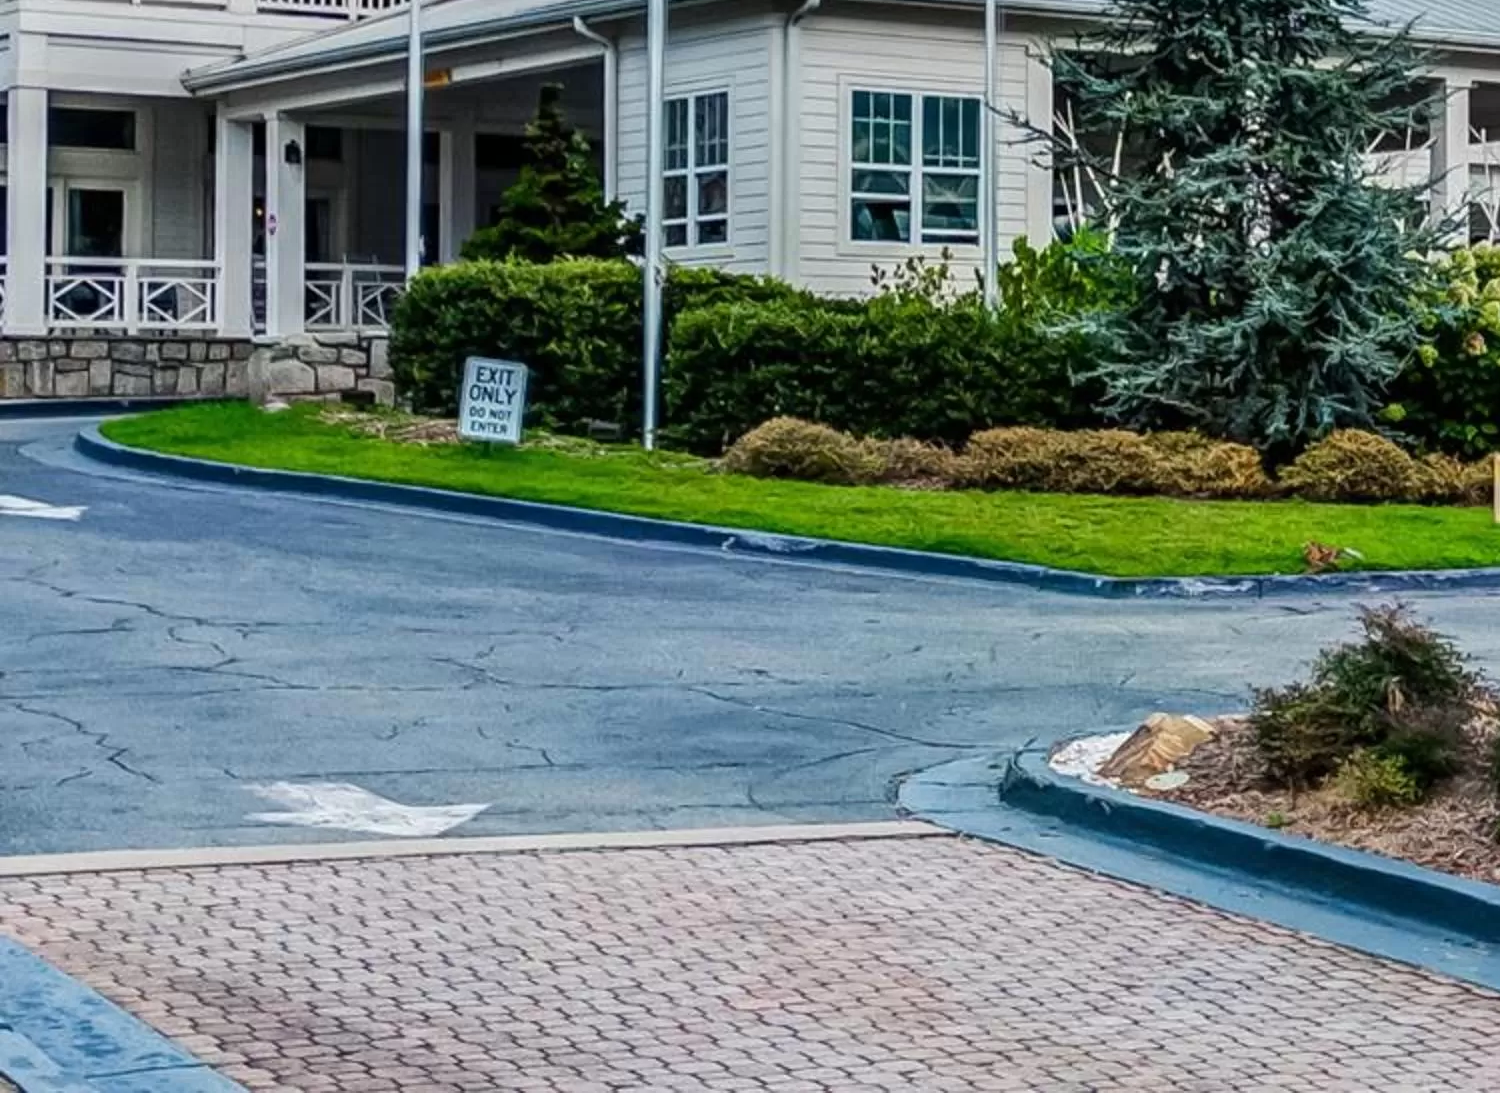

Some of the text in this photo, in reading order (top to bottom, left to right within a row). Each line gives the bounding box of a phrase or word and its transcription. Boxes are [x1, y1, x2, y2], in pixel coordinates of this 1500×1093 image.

[476, 367, 515, 385] EXIT
[469, 384, 518, 405] ONLY
[469, 406, 512, 421] DO NOT
[471, 420, 507, 434] ENTER
